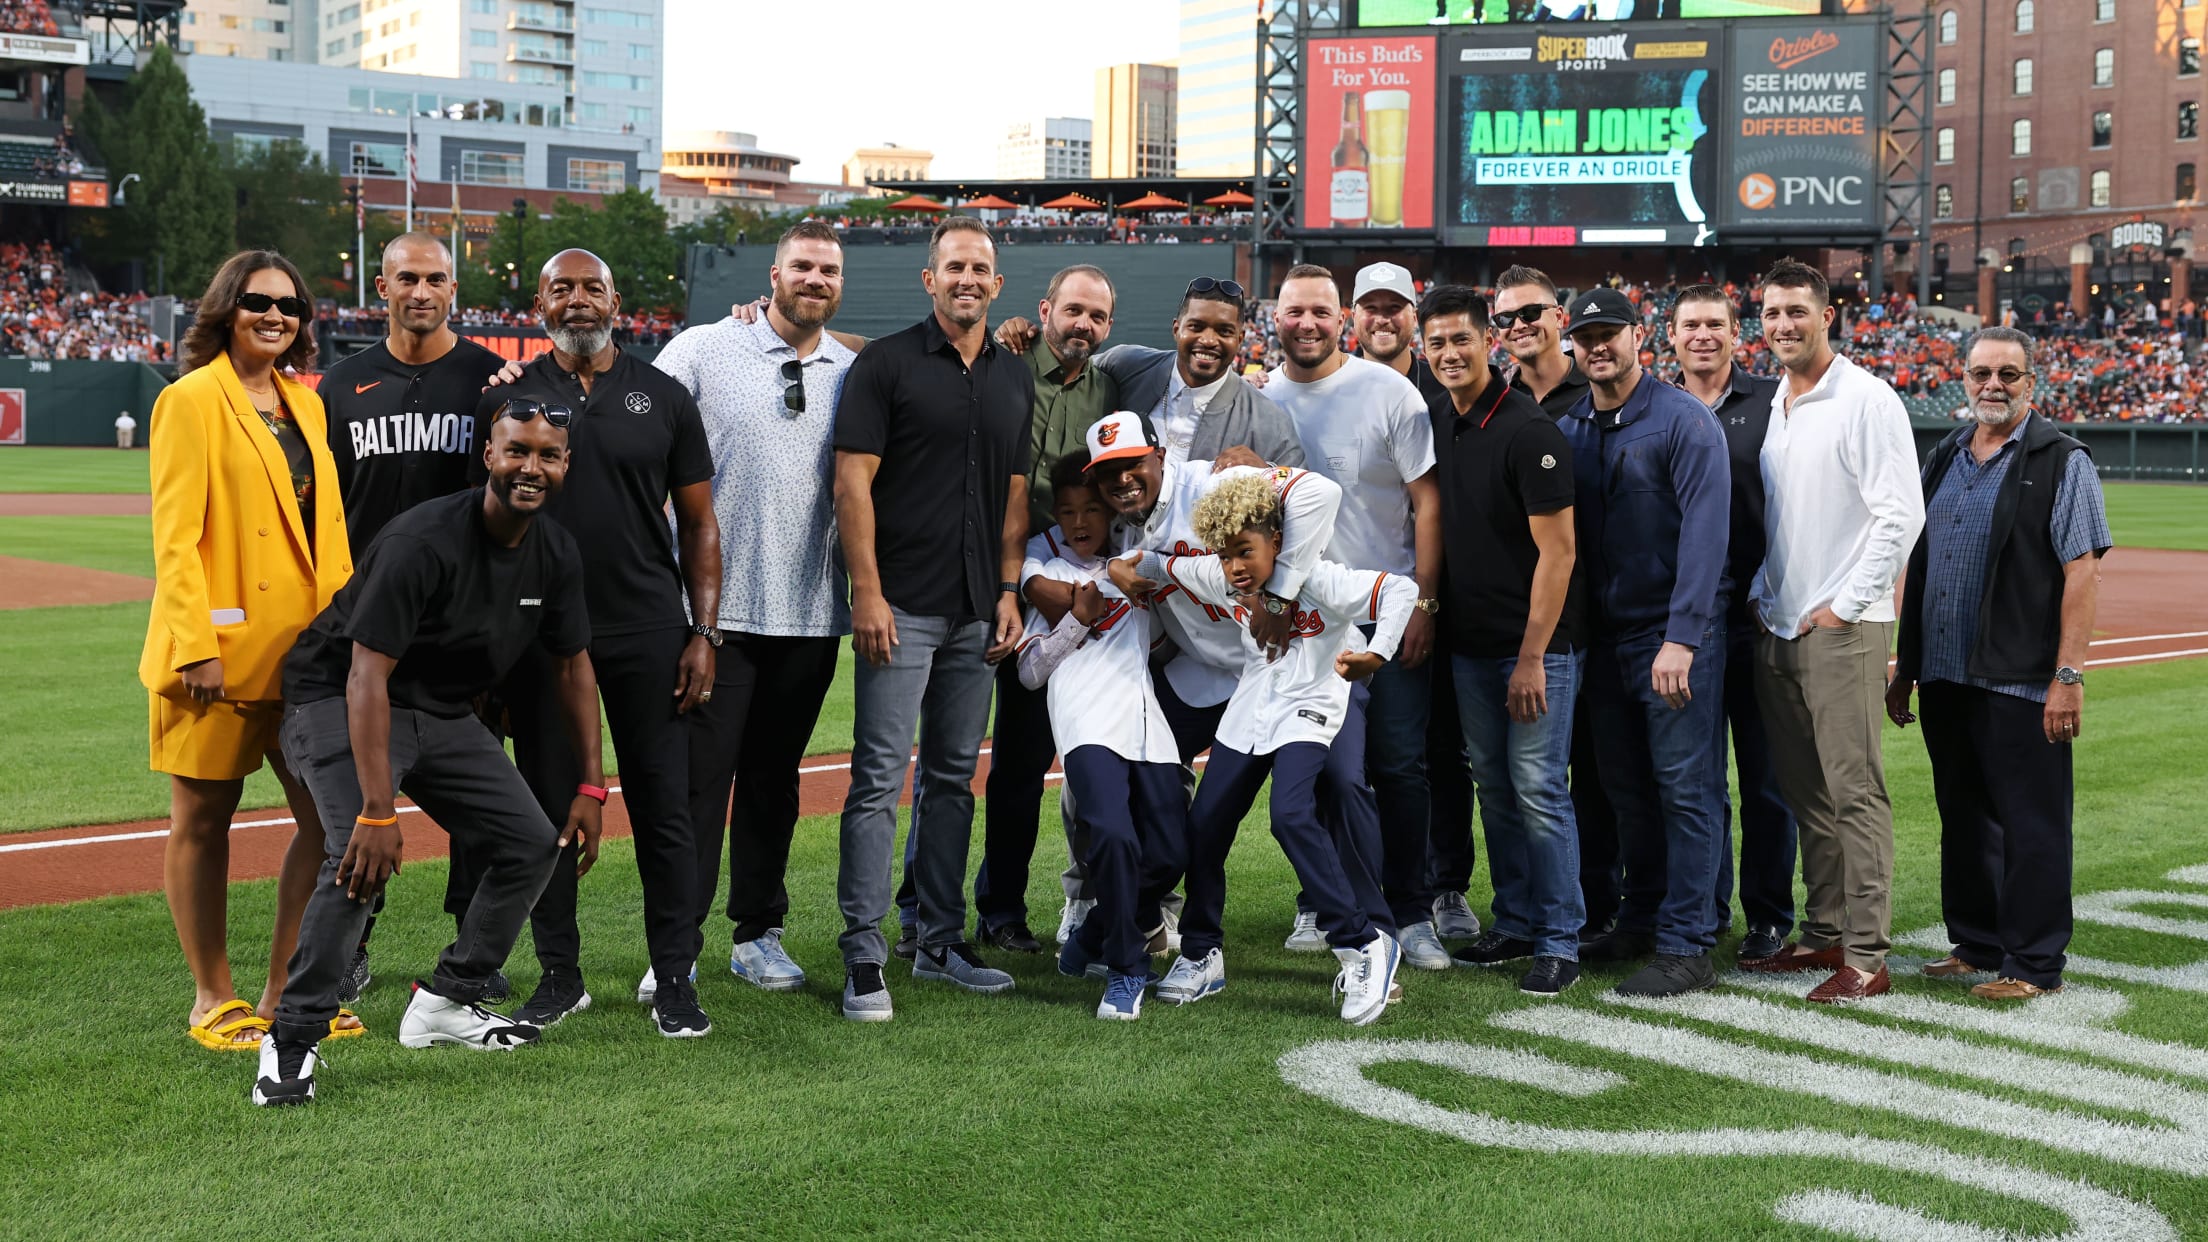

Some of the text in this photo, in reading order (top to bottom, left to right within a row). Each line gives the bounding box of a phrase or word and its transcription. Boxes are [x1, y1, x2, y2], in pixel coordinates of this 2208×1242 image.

[1319, 46, 1366, 64] This
[1537, 34, 1627, 62] SUPERBOOK
[1768, 28, 1840, 69] Orioles
[1557, 60, 1607, 71] SPORTS
[1332, 68, 1410, 86] For You.
[1742, 72, 1867, 92] SEE HOW WE
[1743, 94, 1864, 114] CAN MAKE A
[1469, 107, 1694, 154] ADAM JONES
[1741, 116, 1865, 136] DIFFERENCE
[1482, 160, 1683, 178] FOREVER AN ORIOLE
[1780, 175, 1862, 205] PNC
[1488, 226, 1576, 246] ADAM JONES
[349, 412, 475, 461] BALTIMOR
